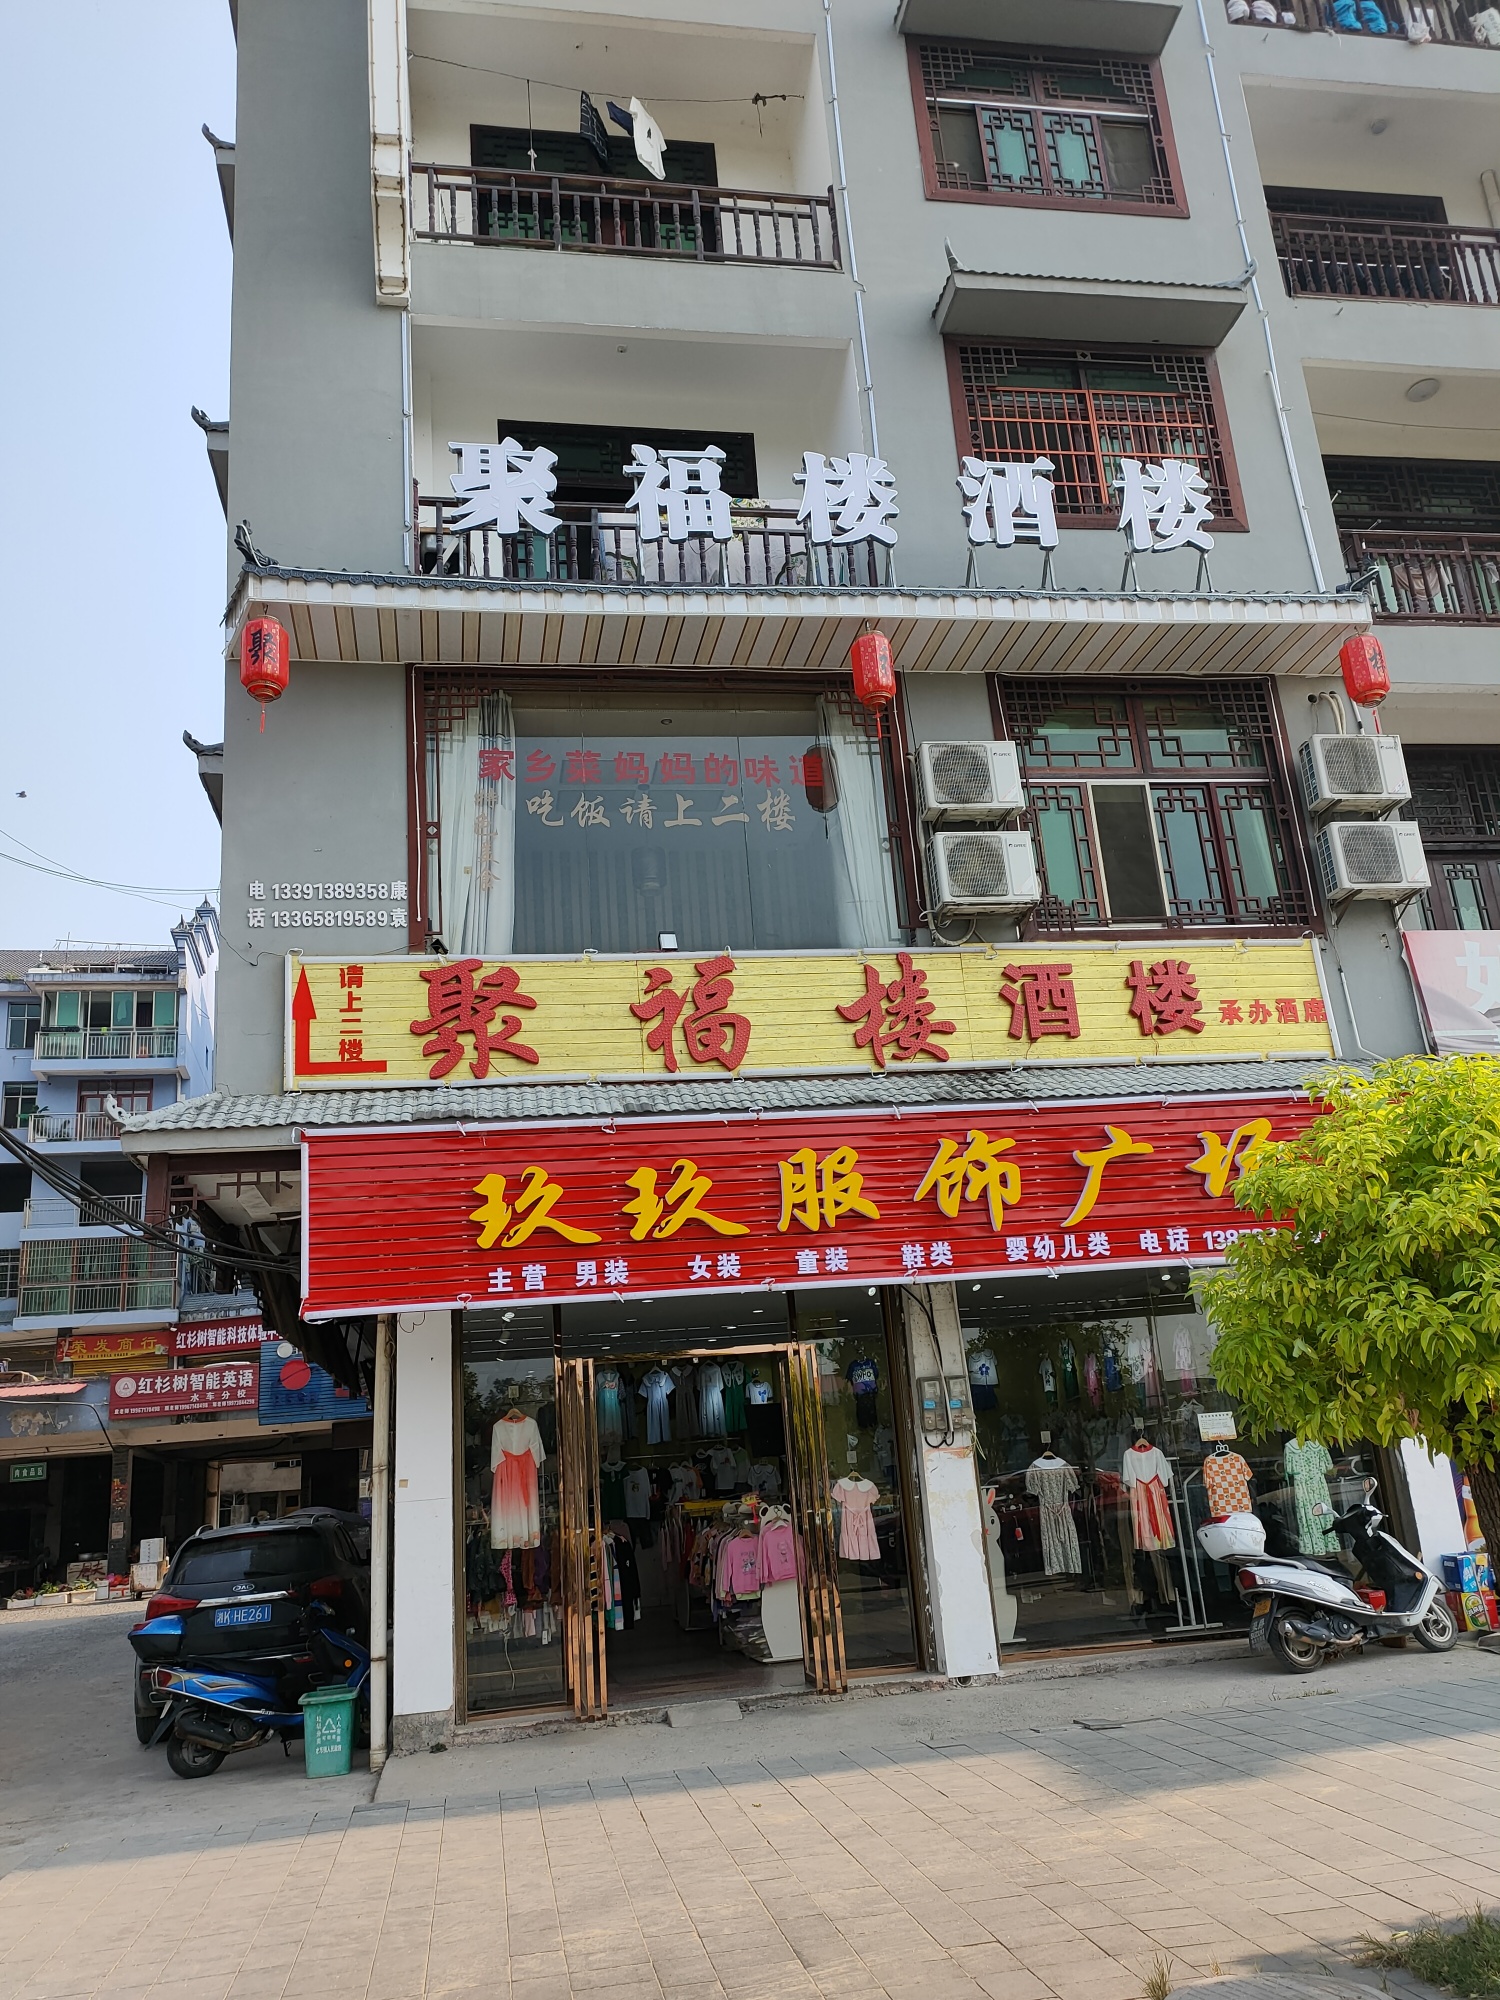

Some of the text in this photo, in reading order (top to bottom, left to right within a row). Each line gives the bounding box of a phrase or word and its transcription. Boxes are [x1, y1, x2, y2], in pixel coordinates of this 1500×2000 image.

[448, 436, 1215, 553] 聚福楼酒楼
[478, 747, 825, 788] 家乡菜妈妈的味道
[525, 788, 797, 833] 吃饭请上二楼
[271, 880, 408, 901] 13391389358康
[271, 907, 408, 928] 13365819589袁
[338, 965, 365, 1063] 请上二楼
[409, 952, 1206, 1080] 聚福楼酒楼
[1218, 997, 1328, 1025] 承办酒席
[487, 1264, 547, 1293] 主营
[574, 1259, 630, 1287] 男装
[687, 1252, 741, 1281] 女装
[795, 1247, 849, 1275] 童装
[901, 1240, 954, 1269] 鞋类
[1005, 1231, 1111, 1262] 婴幼儿类
[1139, 1227, 1190, 1254] 电话
[71, 1335, 158, 1353] 荣发商行
[176, 1323, 284, 1349] 红杉树智能科技体验
[137, 1369, 254, 1395] 红杉树智能英语
[190, 1389, 247, 1402] 水车分校
